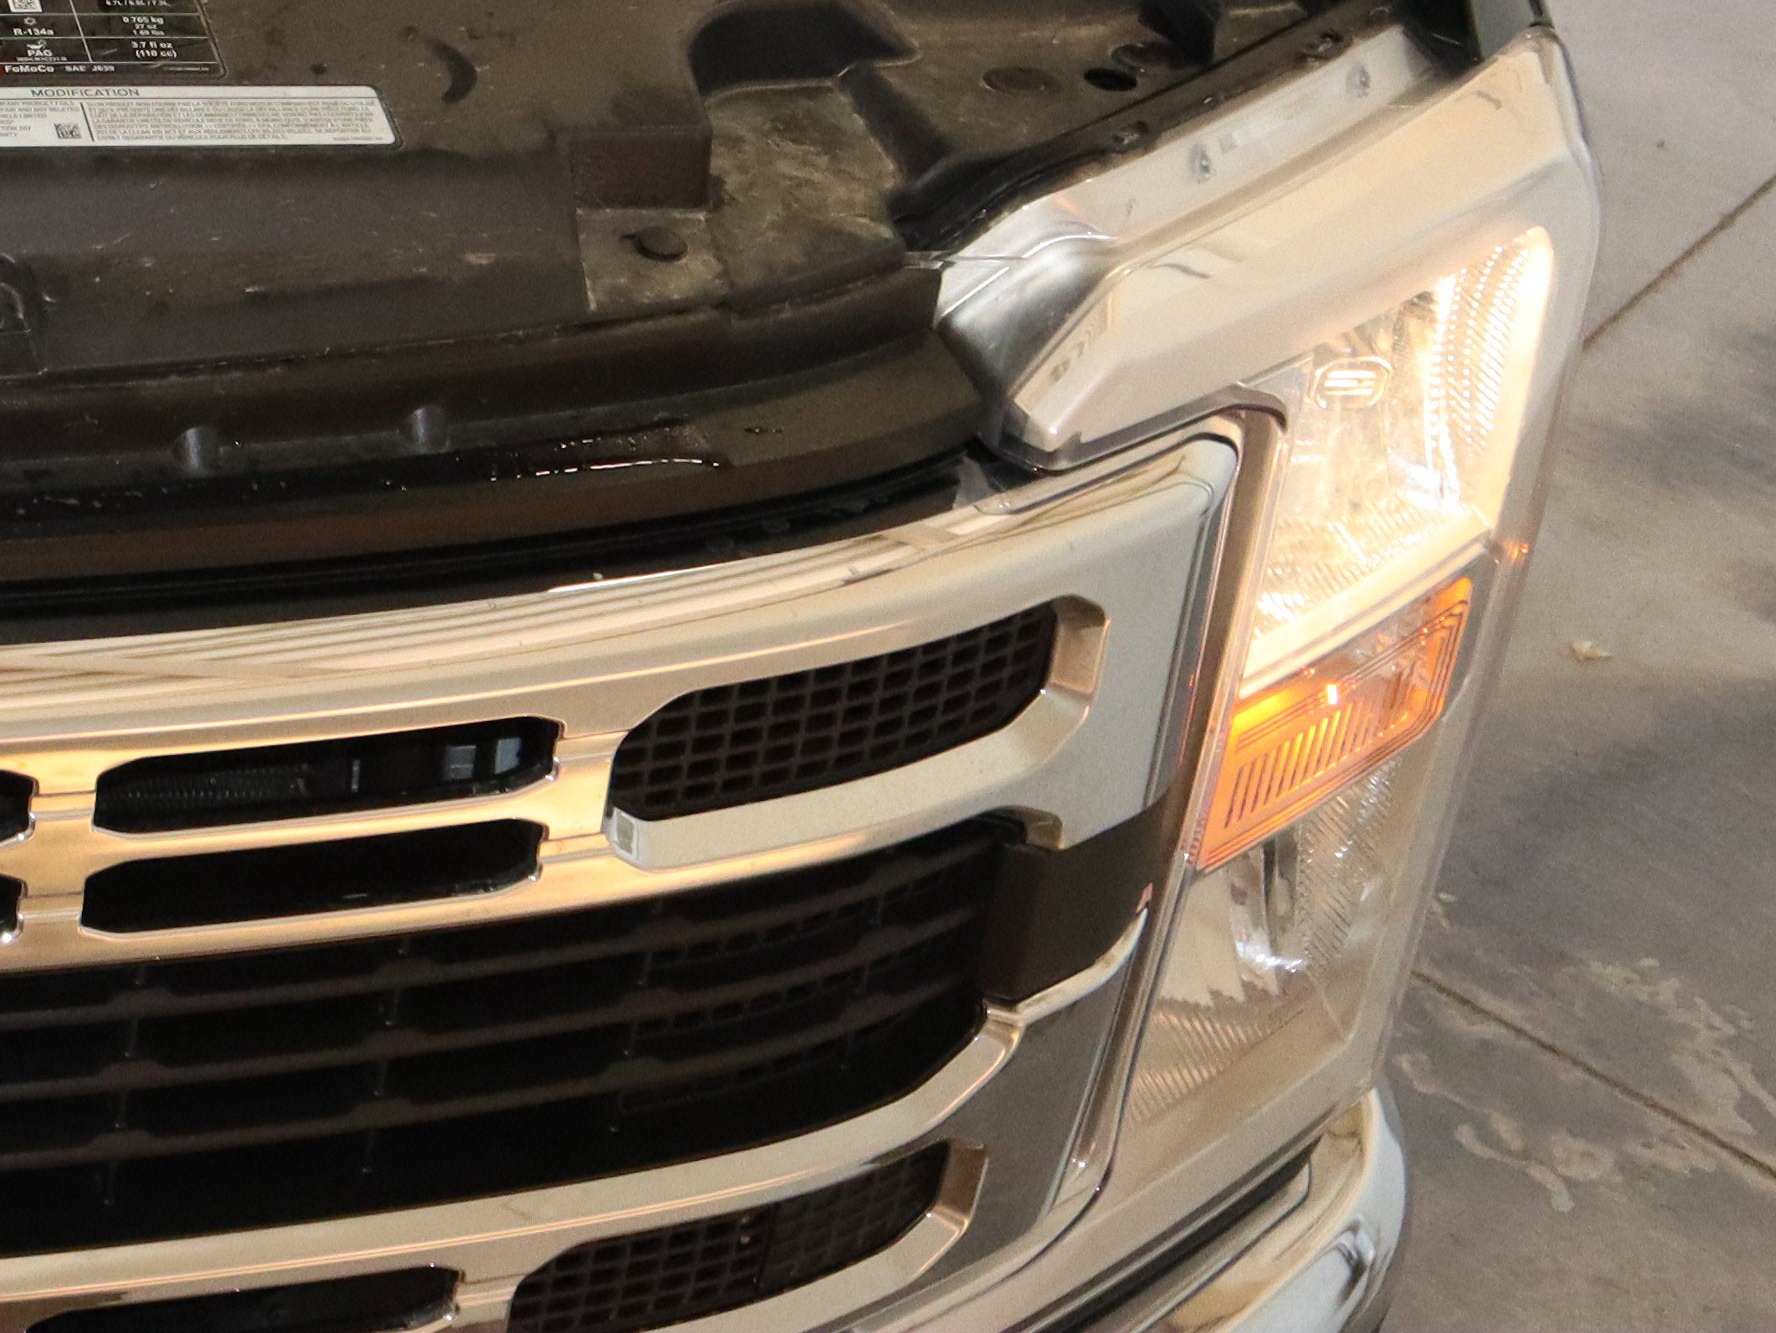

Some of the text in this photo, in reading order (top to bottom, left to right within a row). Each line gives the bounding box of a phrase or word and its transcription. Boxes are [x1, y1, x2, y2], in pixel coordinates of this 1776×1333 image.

[150, 16, 164, 25] kg
[13, 27, 55, 36] R-134a
[26, 49, 53, 57] PAG
[160, 50, 177, 59] cc)
[4, 65, 55, 73] FoMoCo
[31, 88, 141, 97] MODIFICATION
